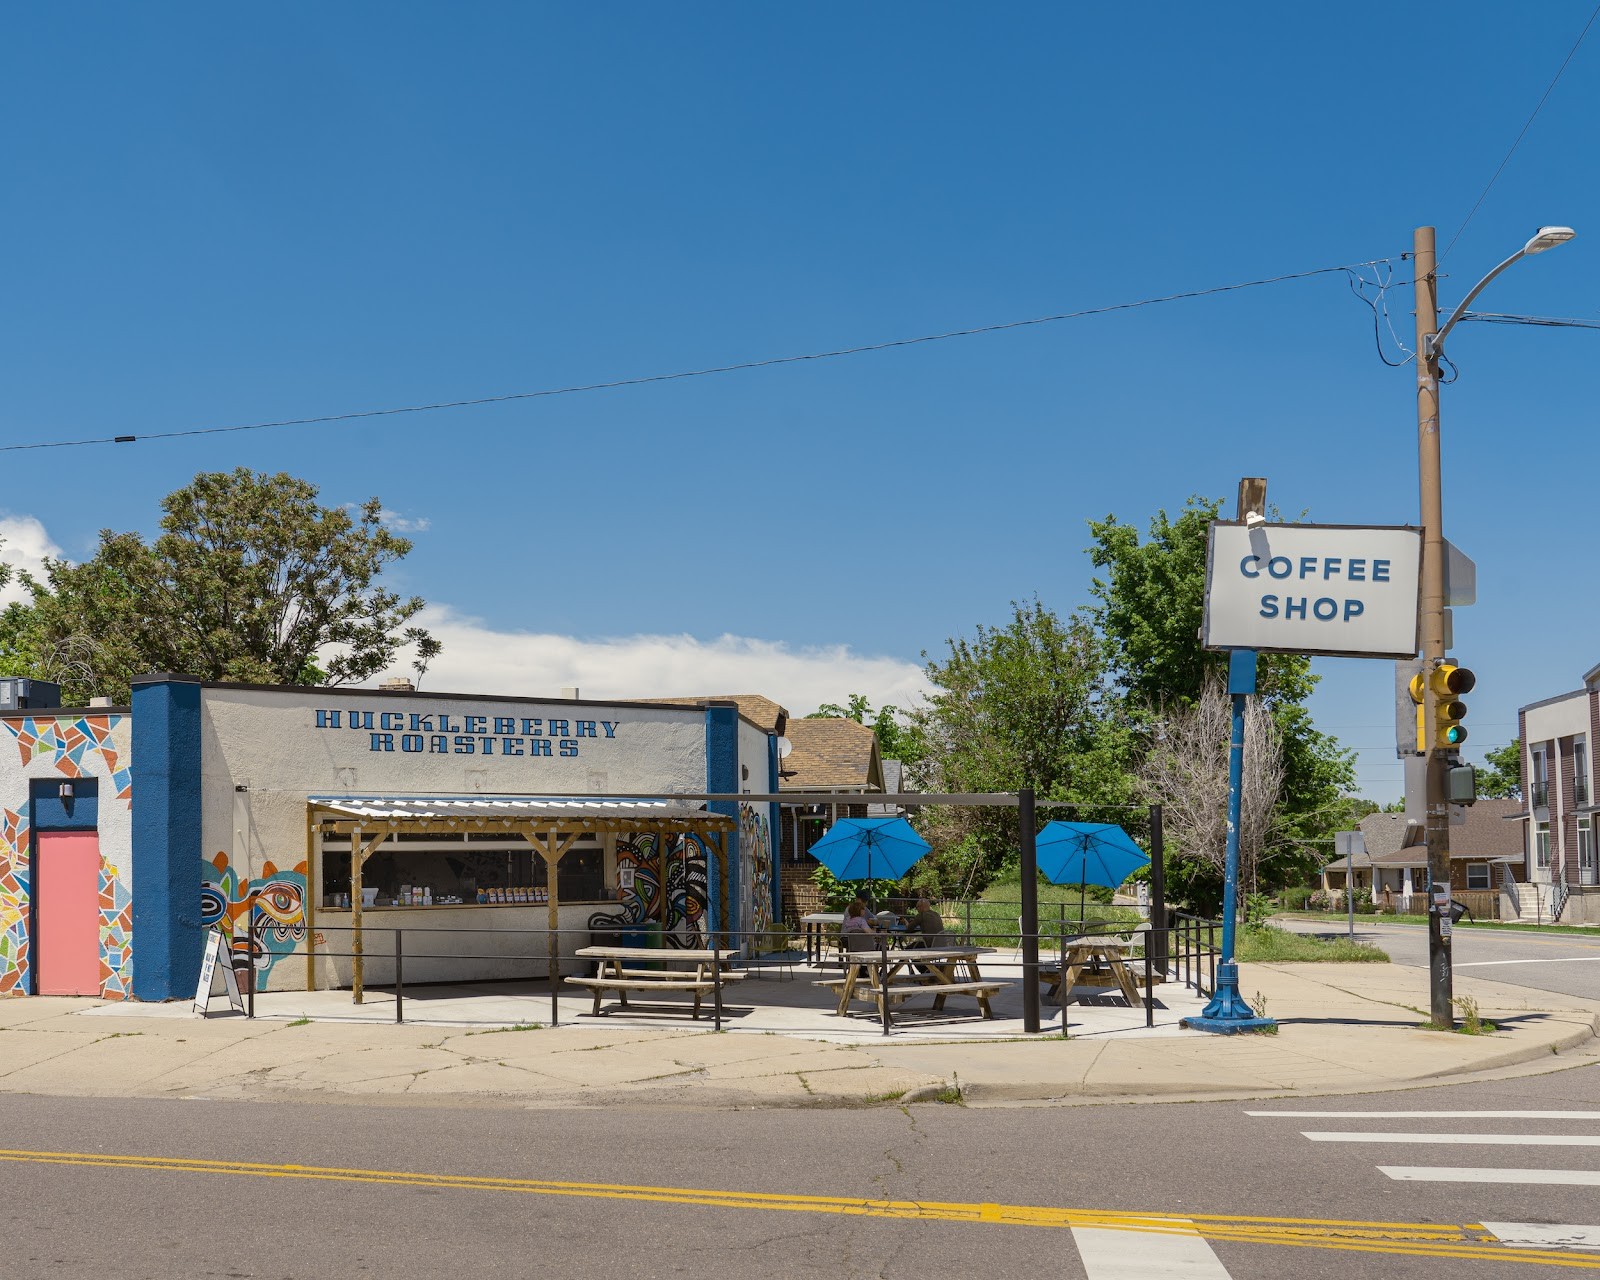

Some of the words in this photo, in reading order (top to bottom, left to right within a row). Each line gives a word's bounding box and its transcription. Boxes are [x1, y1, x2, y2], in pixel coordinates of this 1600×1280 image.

[1240, 555, 1391, 582] COFFEE
[1259, 594, 1365, 622] SHOP
[315, 709, 620, 739] HUCKLEBERRY
[369, 732, 579, 757] ROASTERS
